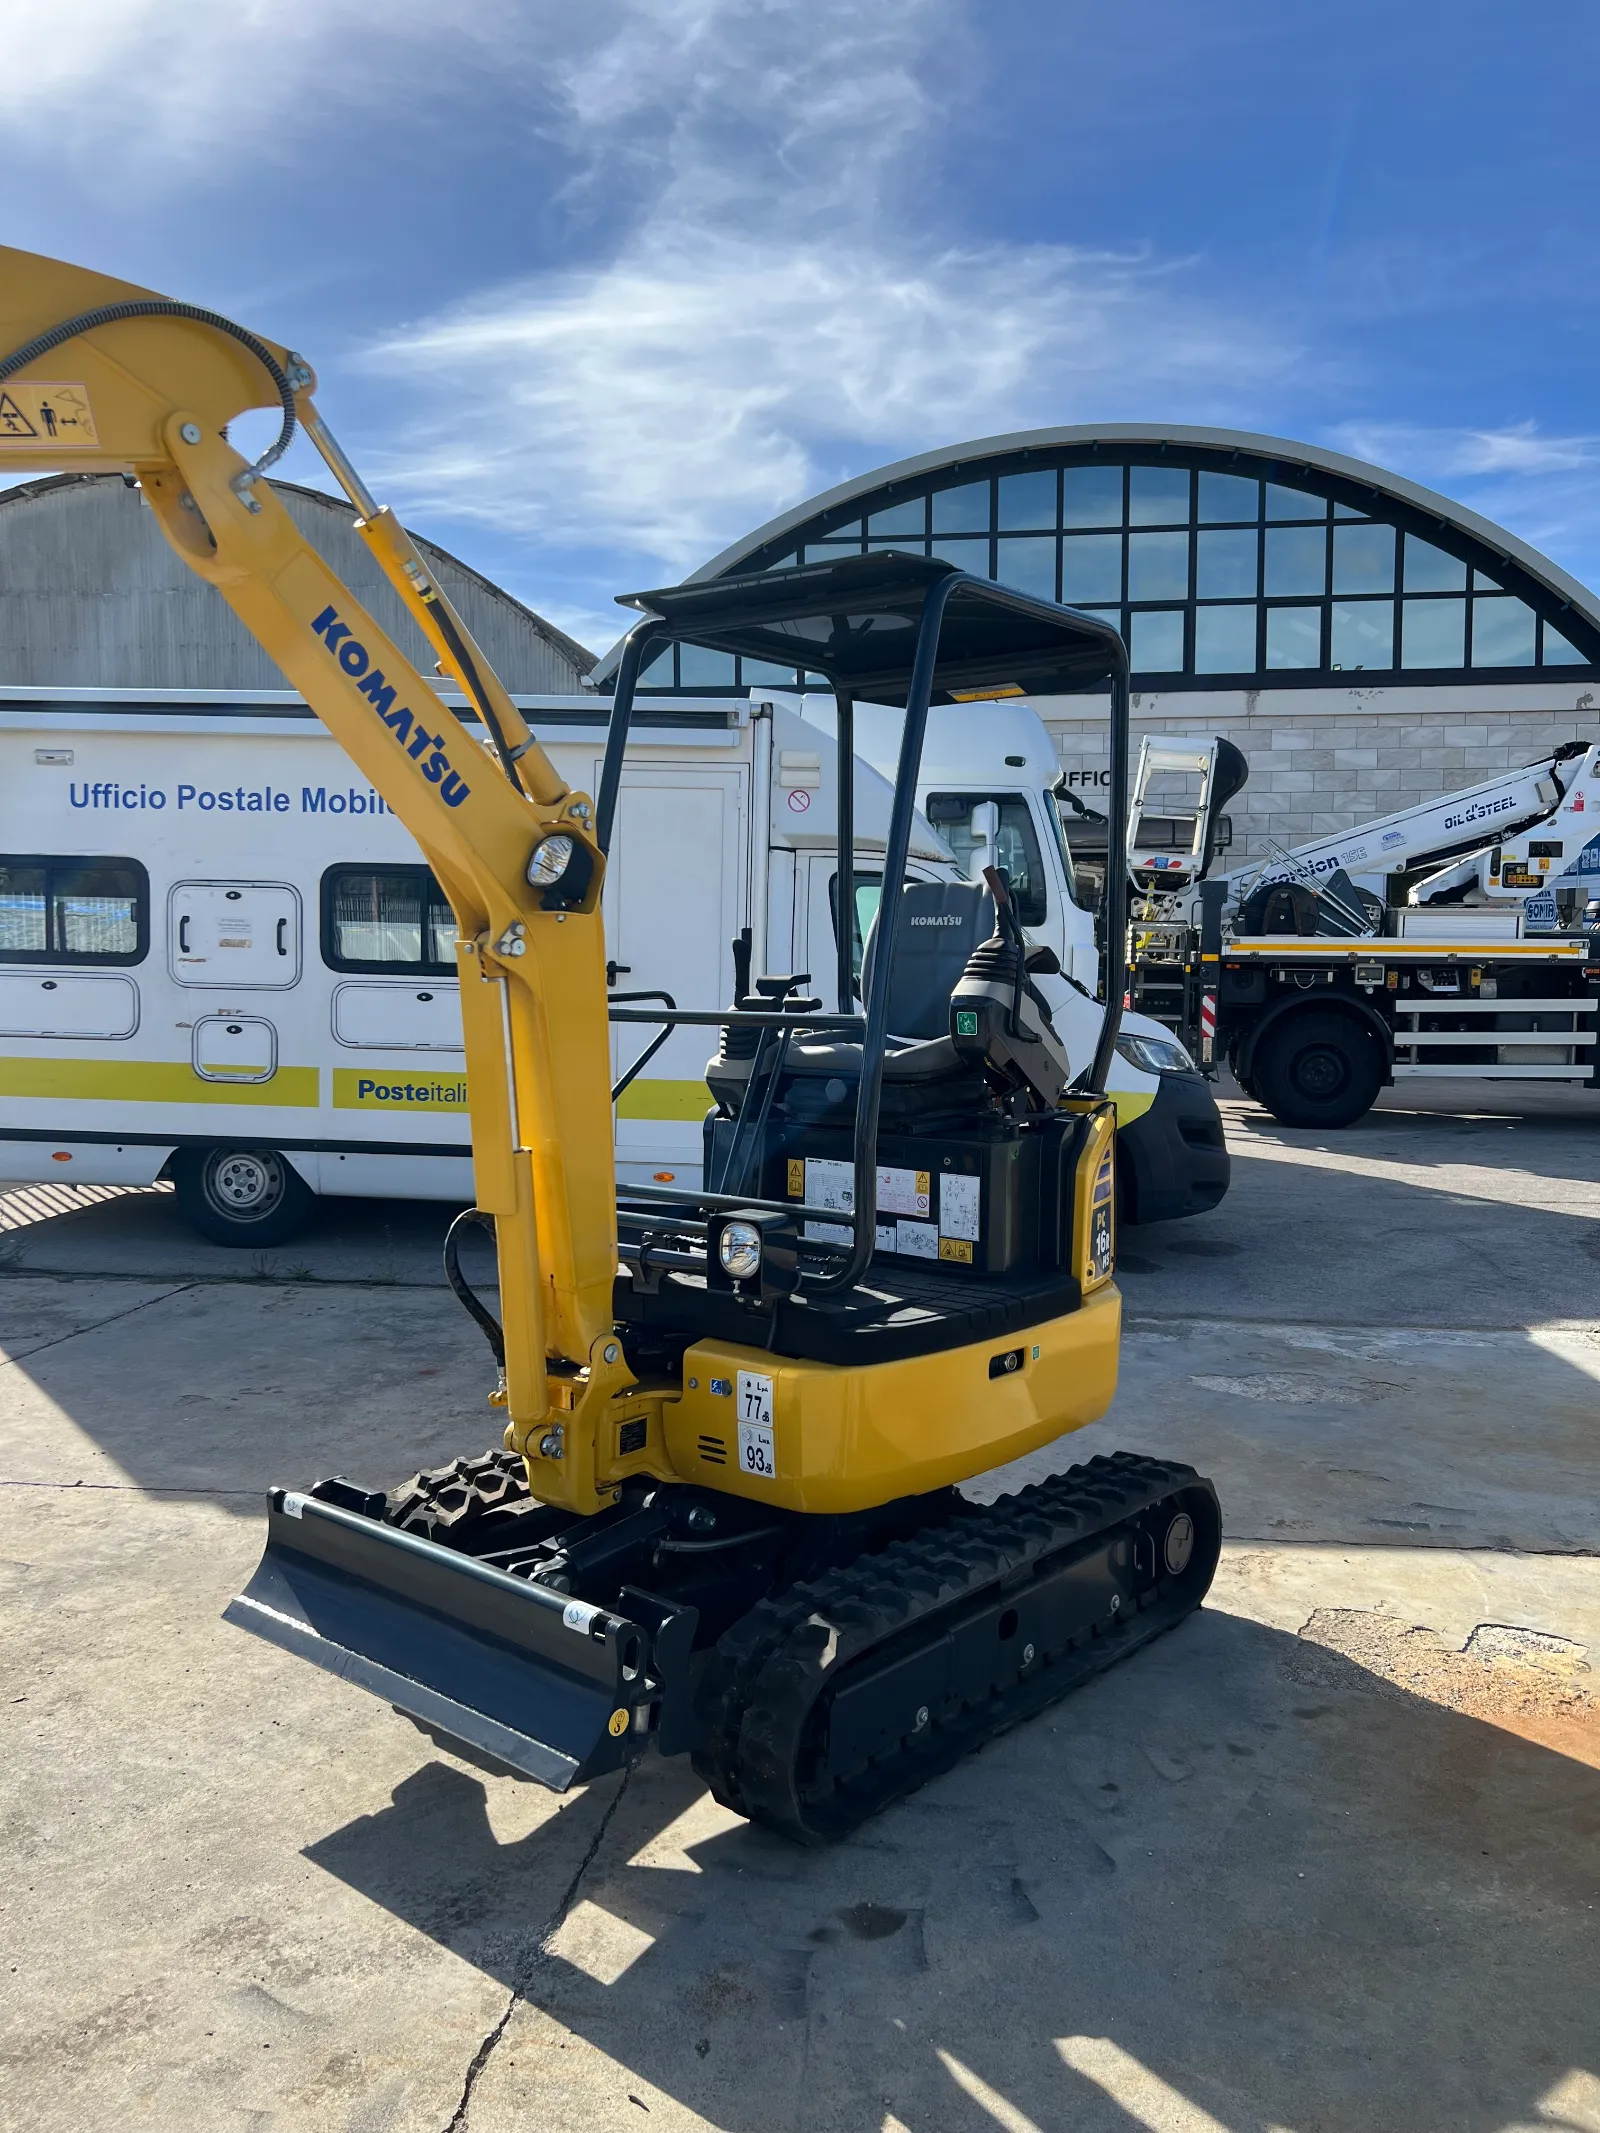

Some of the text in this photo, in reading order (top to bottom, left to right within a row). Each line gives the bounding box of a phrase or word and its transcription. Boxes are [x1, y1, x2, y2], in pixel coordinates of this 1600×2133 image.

[311, 604, 471, 808] KOMATSU
[1062, 770, 1110, 787] FFIC
[69, 783, 167, 809] Ufficio
[177, 784, 290, 812] Postale
[911, 914, 962, 926] KOMATSU
[358, 1079, 468, 1103] Posteitali
[1097, 1210, 1105, 1230] PC
[745, 1393, 762, 1419] 77
[747, 1445, 765, 1472] 93
